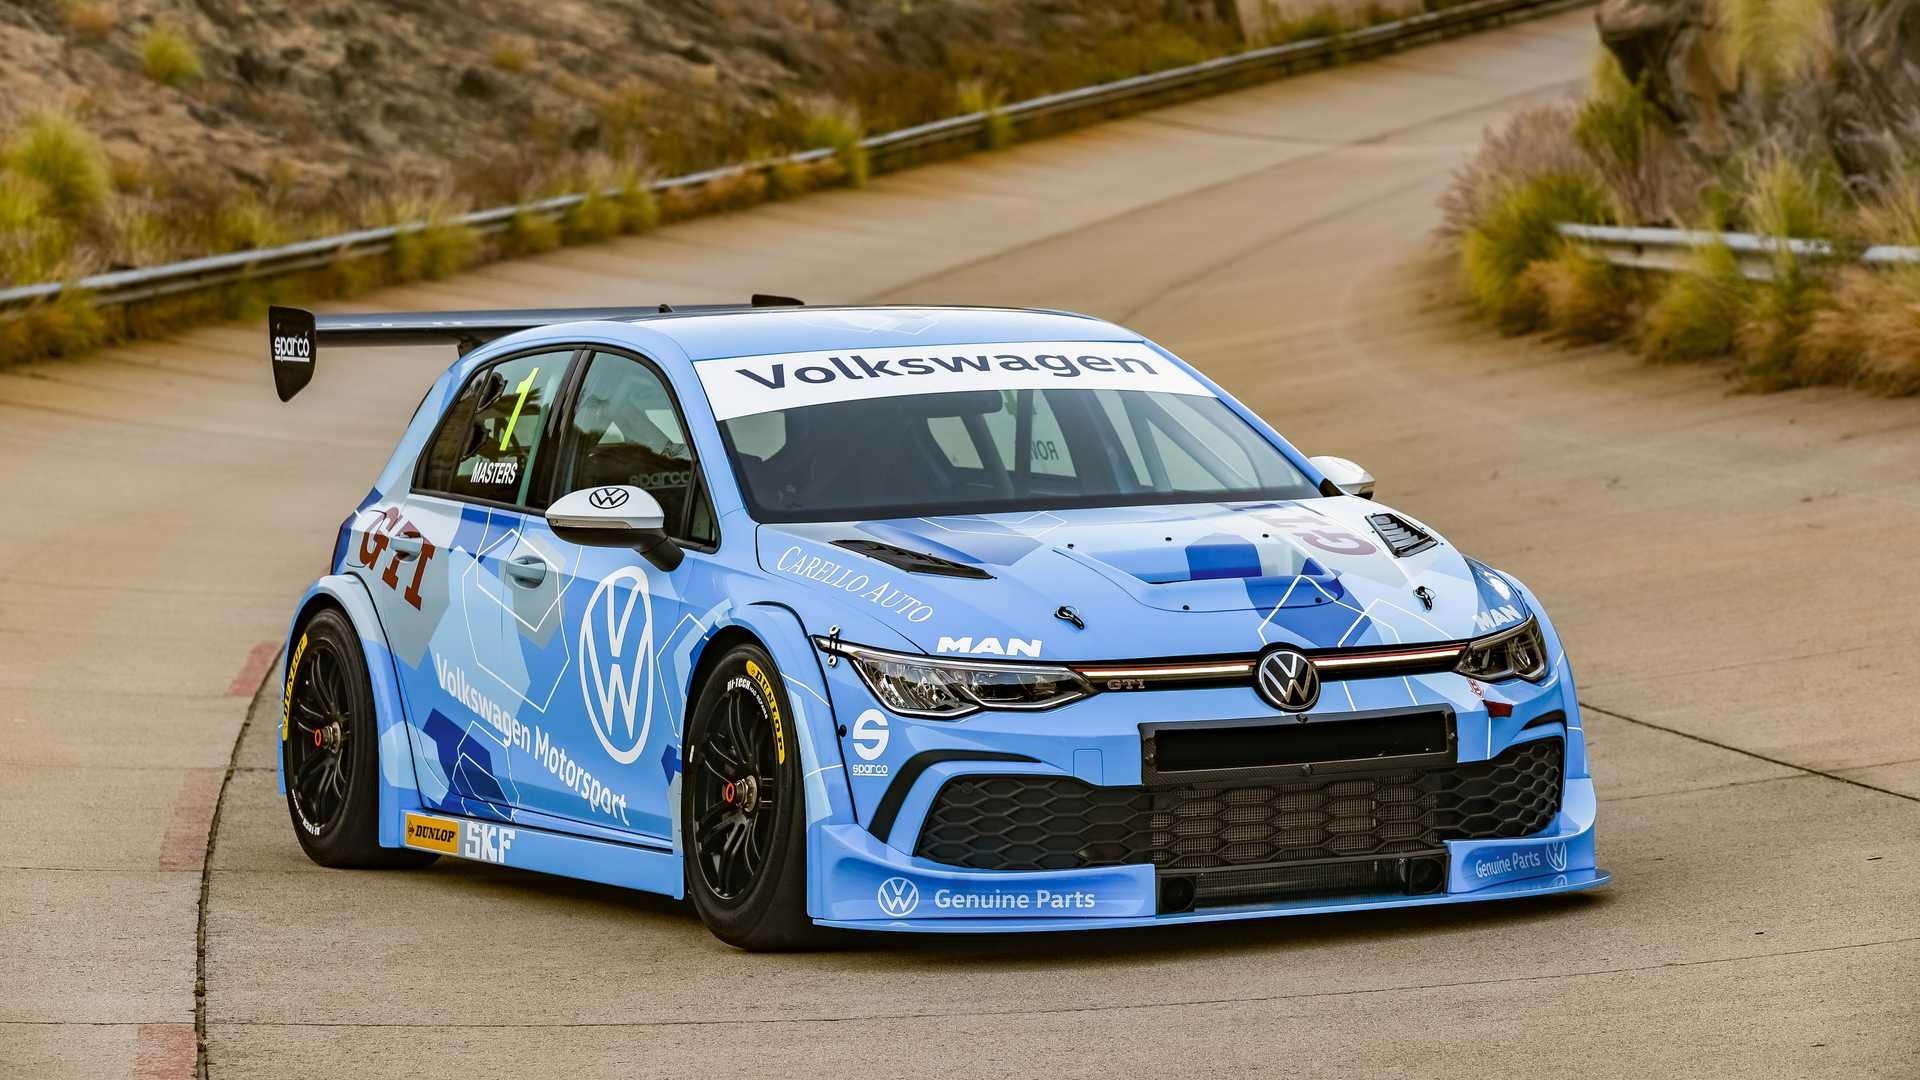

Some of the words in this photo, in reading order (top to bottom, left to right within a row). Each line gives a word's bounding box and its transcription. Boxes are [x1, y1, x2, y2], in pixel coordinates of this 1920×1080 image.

[274, 336, 310, 361] sparco
[735, 354, 1159, 389] Volkswagen
[500, 368, 540, 451] 1
[470, 462, 518, 484] MASTERS
[360, 507, 436, 611] GTI
[777, 546, 869, 592] CARELLO
[860, 582, 934, 622] AUTO
[1472, 605, 1523, 632] MAN
[937, 637, 1042, 658] MAN
[1107, 679, 1145, 690] GTI
[756, 670, 784, 752] DUNLOP
[436, 653, 531, 753] Volkswagen
[535, 726, 629, 826] Motorsport
[853, 764, 888, 776] sparco
[416, 825, 455, 842] DUNLOP
[465, 821, 515, 863] SKF
[1475, 857, 1511, 878] Genuine
[1512, 851, 1541, 871] Parts
[935, 889, 1029, 909] Genuine
[1036, 889, 1096, 909] Parts
